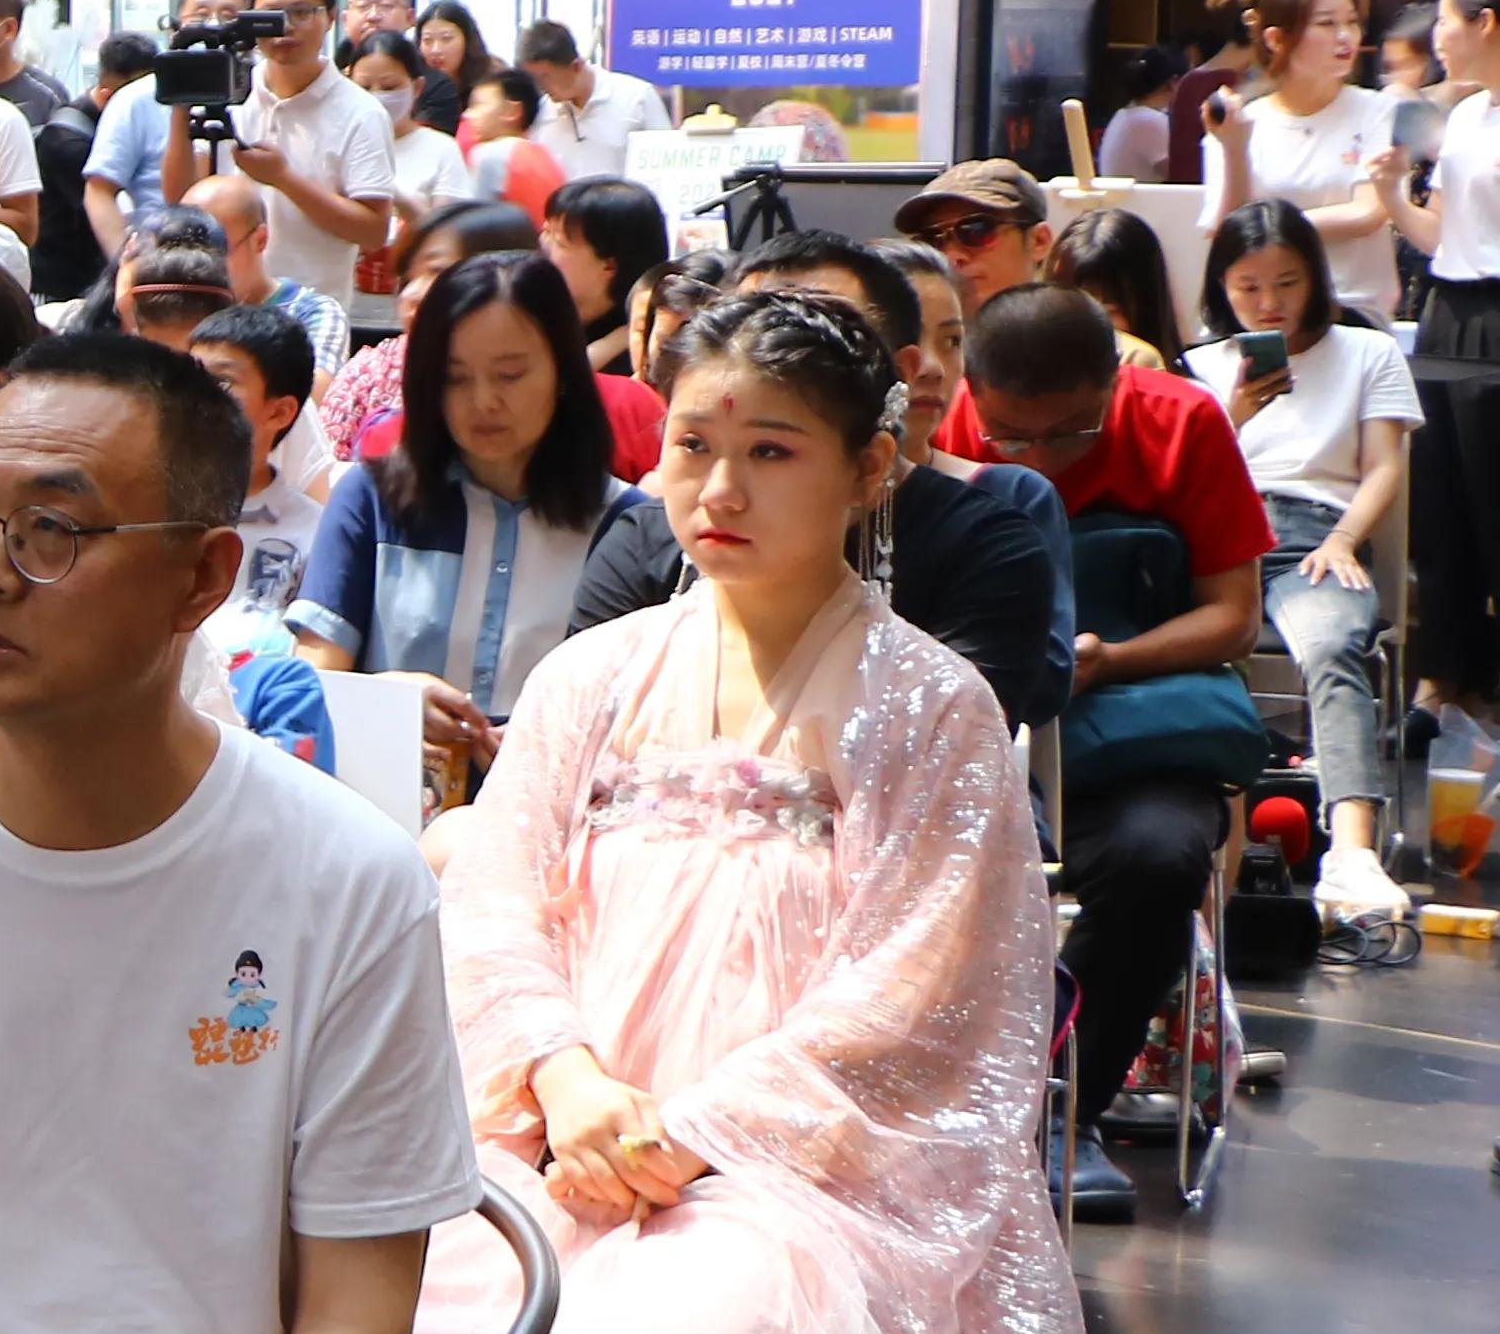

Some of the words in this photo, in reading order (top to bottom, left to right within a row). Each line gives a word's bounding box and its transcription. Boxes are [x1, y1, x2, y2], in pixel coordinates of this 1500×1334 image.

[631, 28, 660, 46] 英语
[672, 28, 701, 46] 运动
[714, 27, 743, 45] 自然
[755, 27, 785, 45] 艺术
[797, 27, 828, 44] 游戏
[839, 27, 893, 42] STEAM
[638, 146, 721, 169] SUMMER
[729, 144, 787, 166] CAMP
